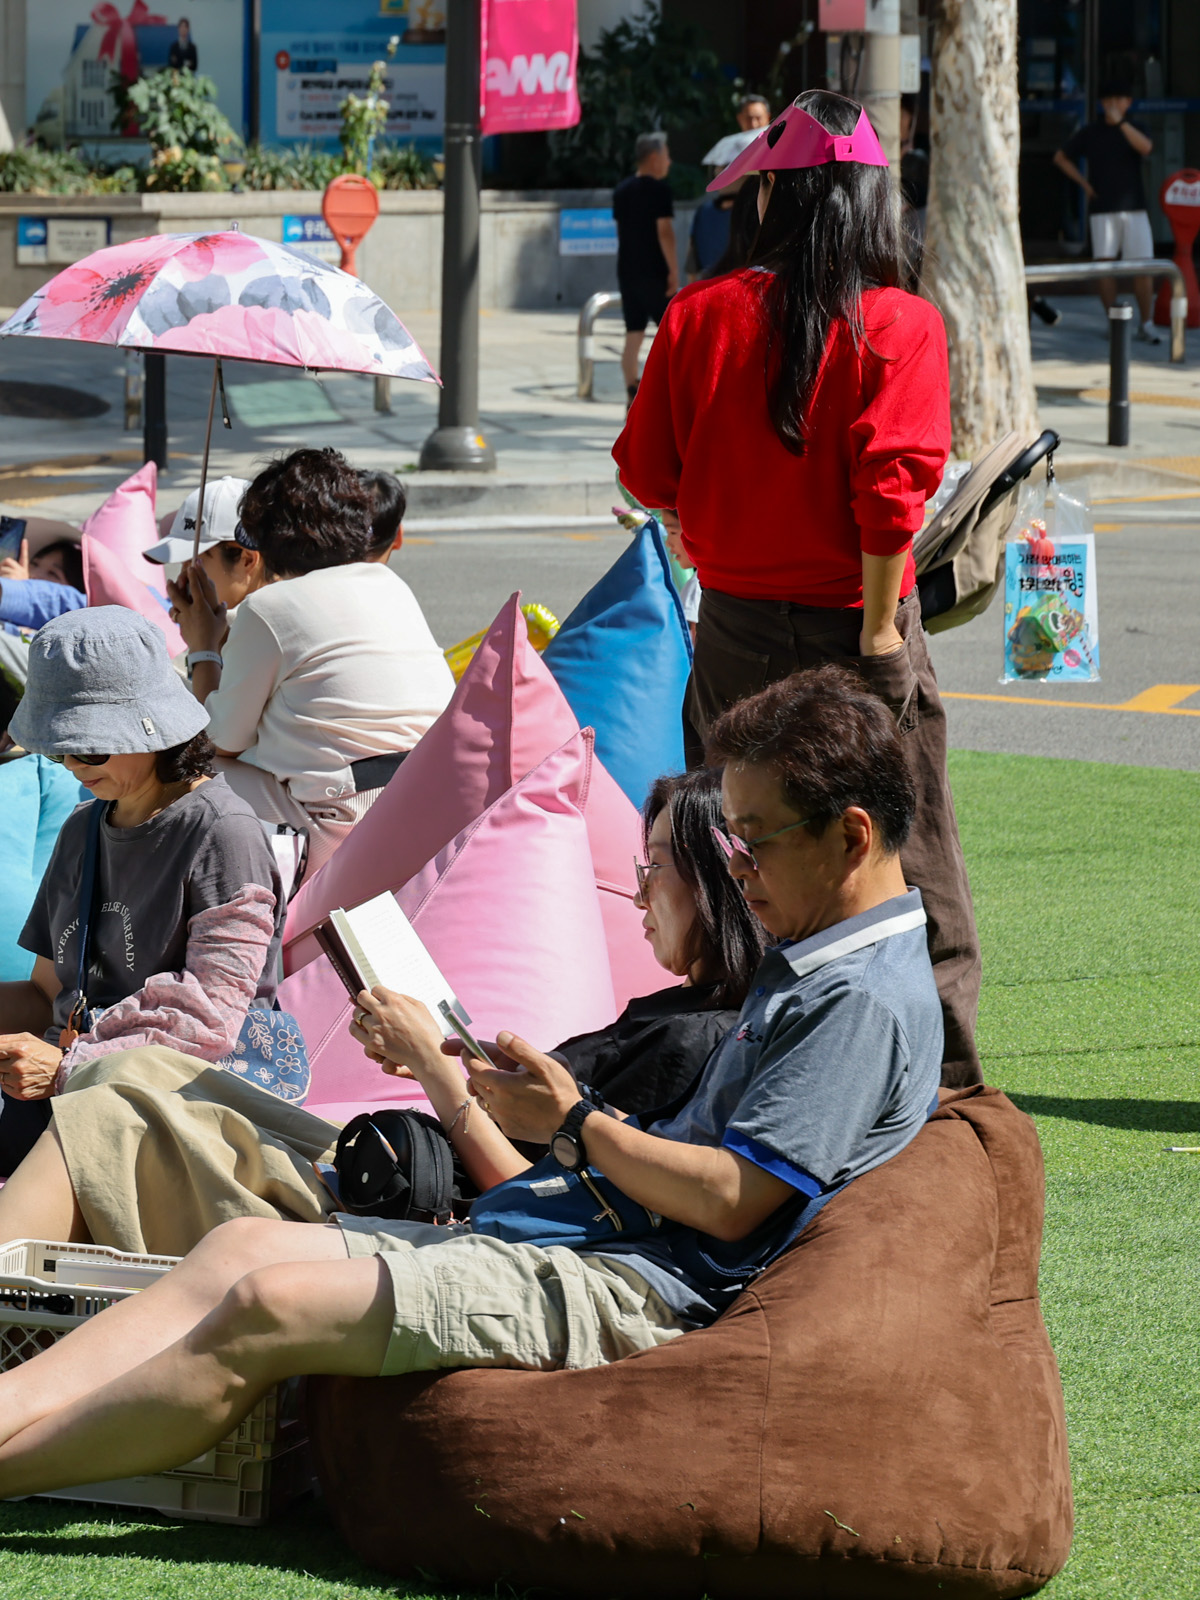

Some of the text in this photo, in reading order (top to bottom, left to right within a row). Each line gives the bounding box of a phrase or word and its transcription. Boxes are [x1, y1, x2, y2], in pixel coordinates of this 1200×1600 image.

[101, 901, 121, 913] ELSE
[119, 904, 129, 917] IS
[123, 912, 135, 972] ALREADY
